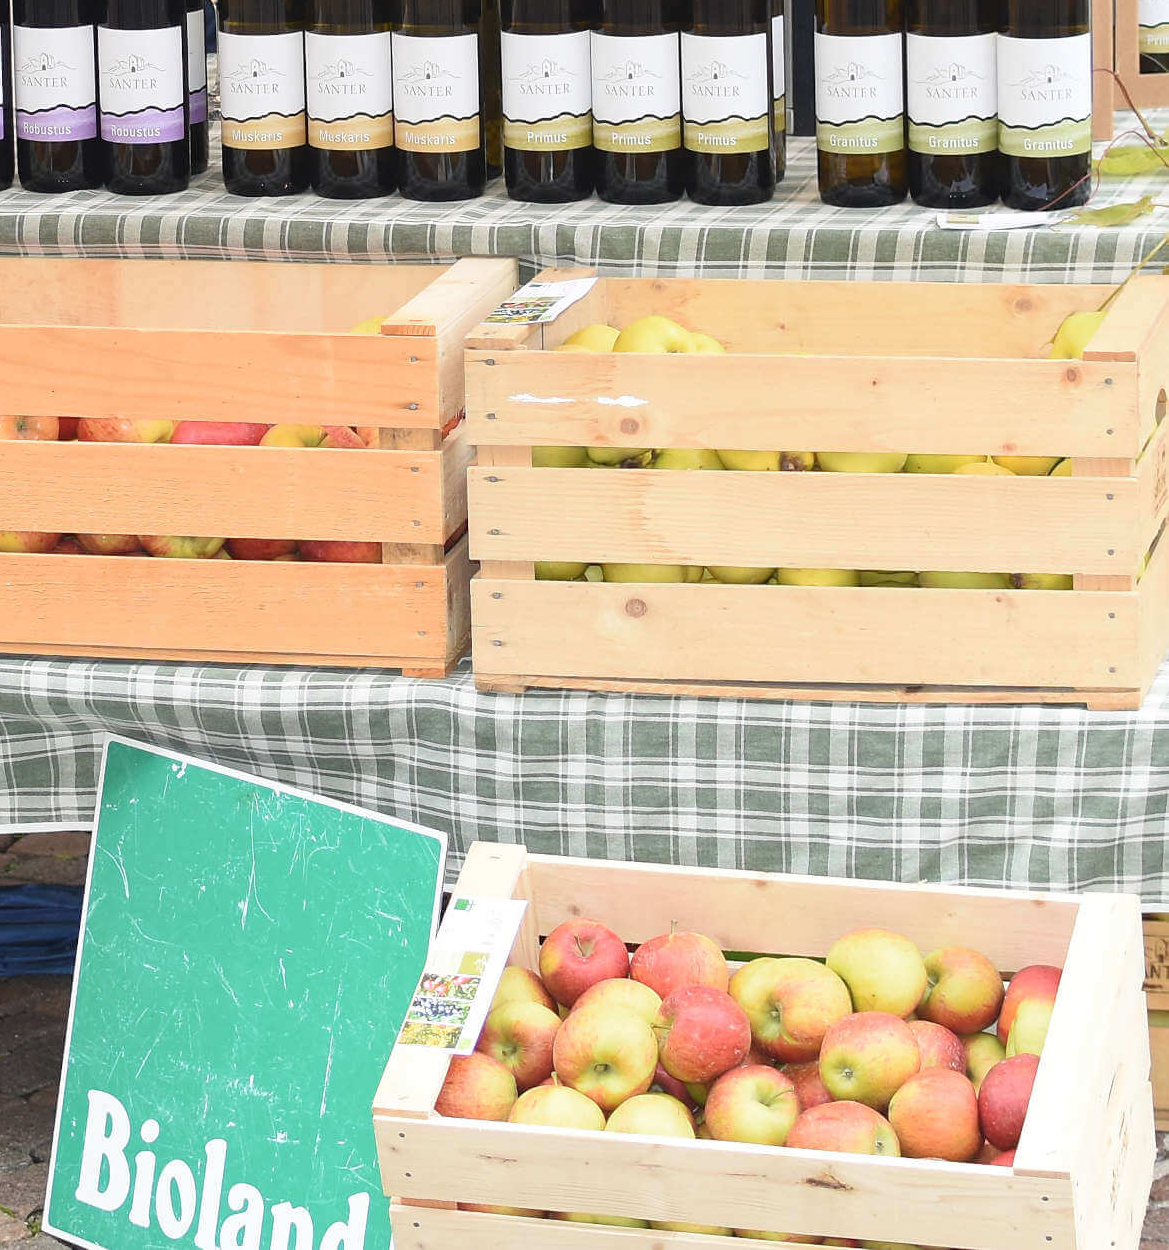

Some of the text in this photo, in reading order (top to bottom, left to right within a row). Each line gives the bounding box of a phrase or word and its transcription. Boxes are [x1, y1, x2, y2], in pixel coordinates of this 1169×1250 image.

[21, 76, 69, 88] SANTER
[109, 77, 157, 90] SANTER
[230, 83, 279, 95] SANTER
[318, 83, 367, 95] SANTER
[403, 84, 453, 97] SANTER
[520, 83, 571, 95] SANTER
[605, 85, 655, 97] SANTER
[692, 84, 741, 97] SANTER
[826, 87, 878, 99] SANTER
[926, 87, 978, 99] SANTER
[1021, 88, 1073, 101] SANTER
[23, 122, 72, 136] Robustus
[111, 124, 161, 137] Robustus
[232, 129, 283, 142] Muskaris
[319, 129, 370, 143] Muskaris
[405, 131, 455, 145] Muskaris
[527, 131, 567, 143] Primus
[612, 132, 651, 145] Primus
[698, 132, 737, 146] Primus
[830, 134, 879, 148] Granitus
[928, 135, 979, 148] Granitus
[1024, 138, 1074, 151] Granitus
[75, 1089, 370, 1250] Bioland
